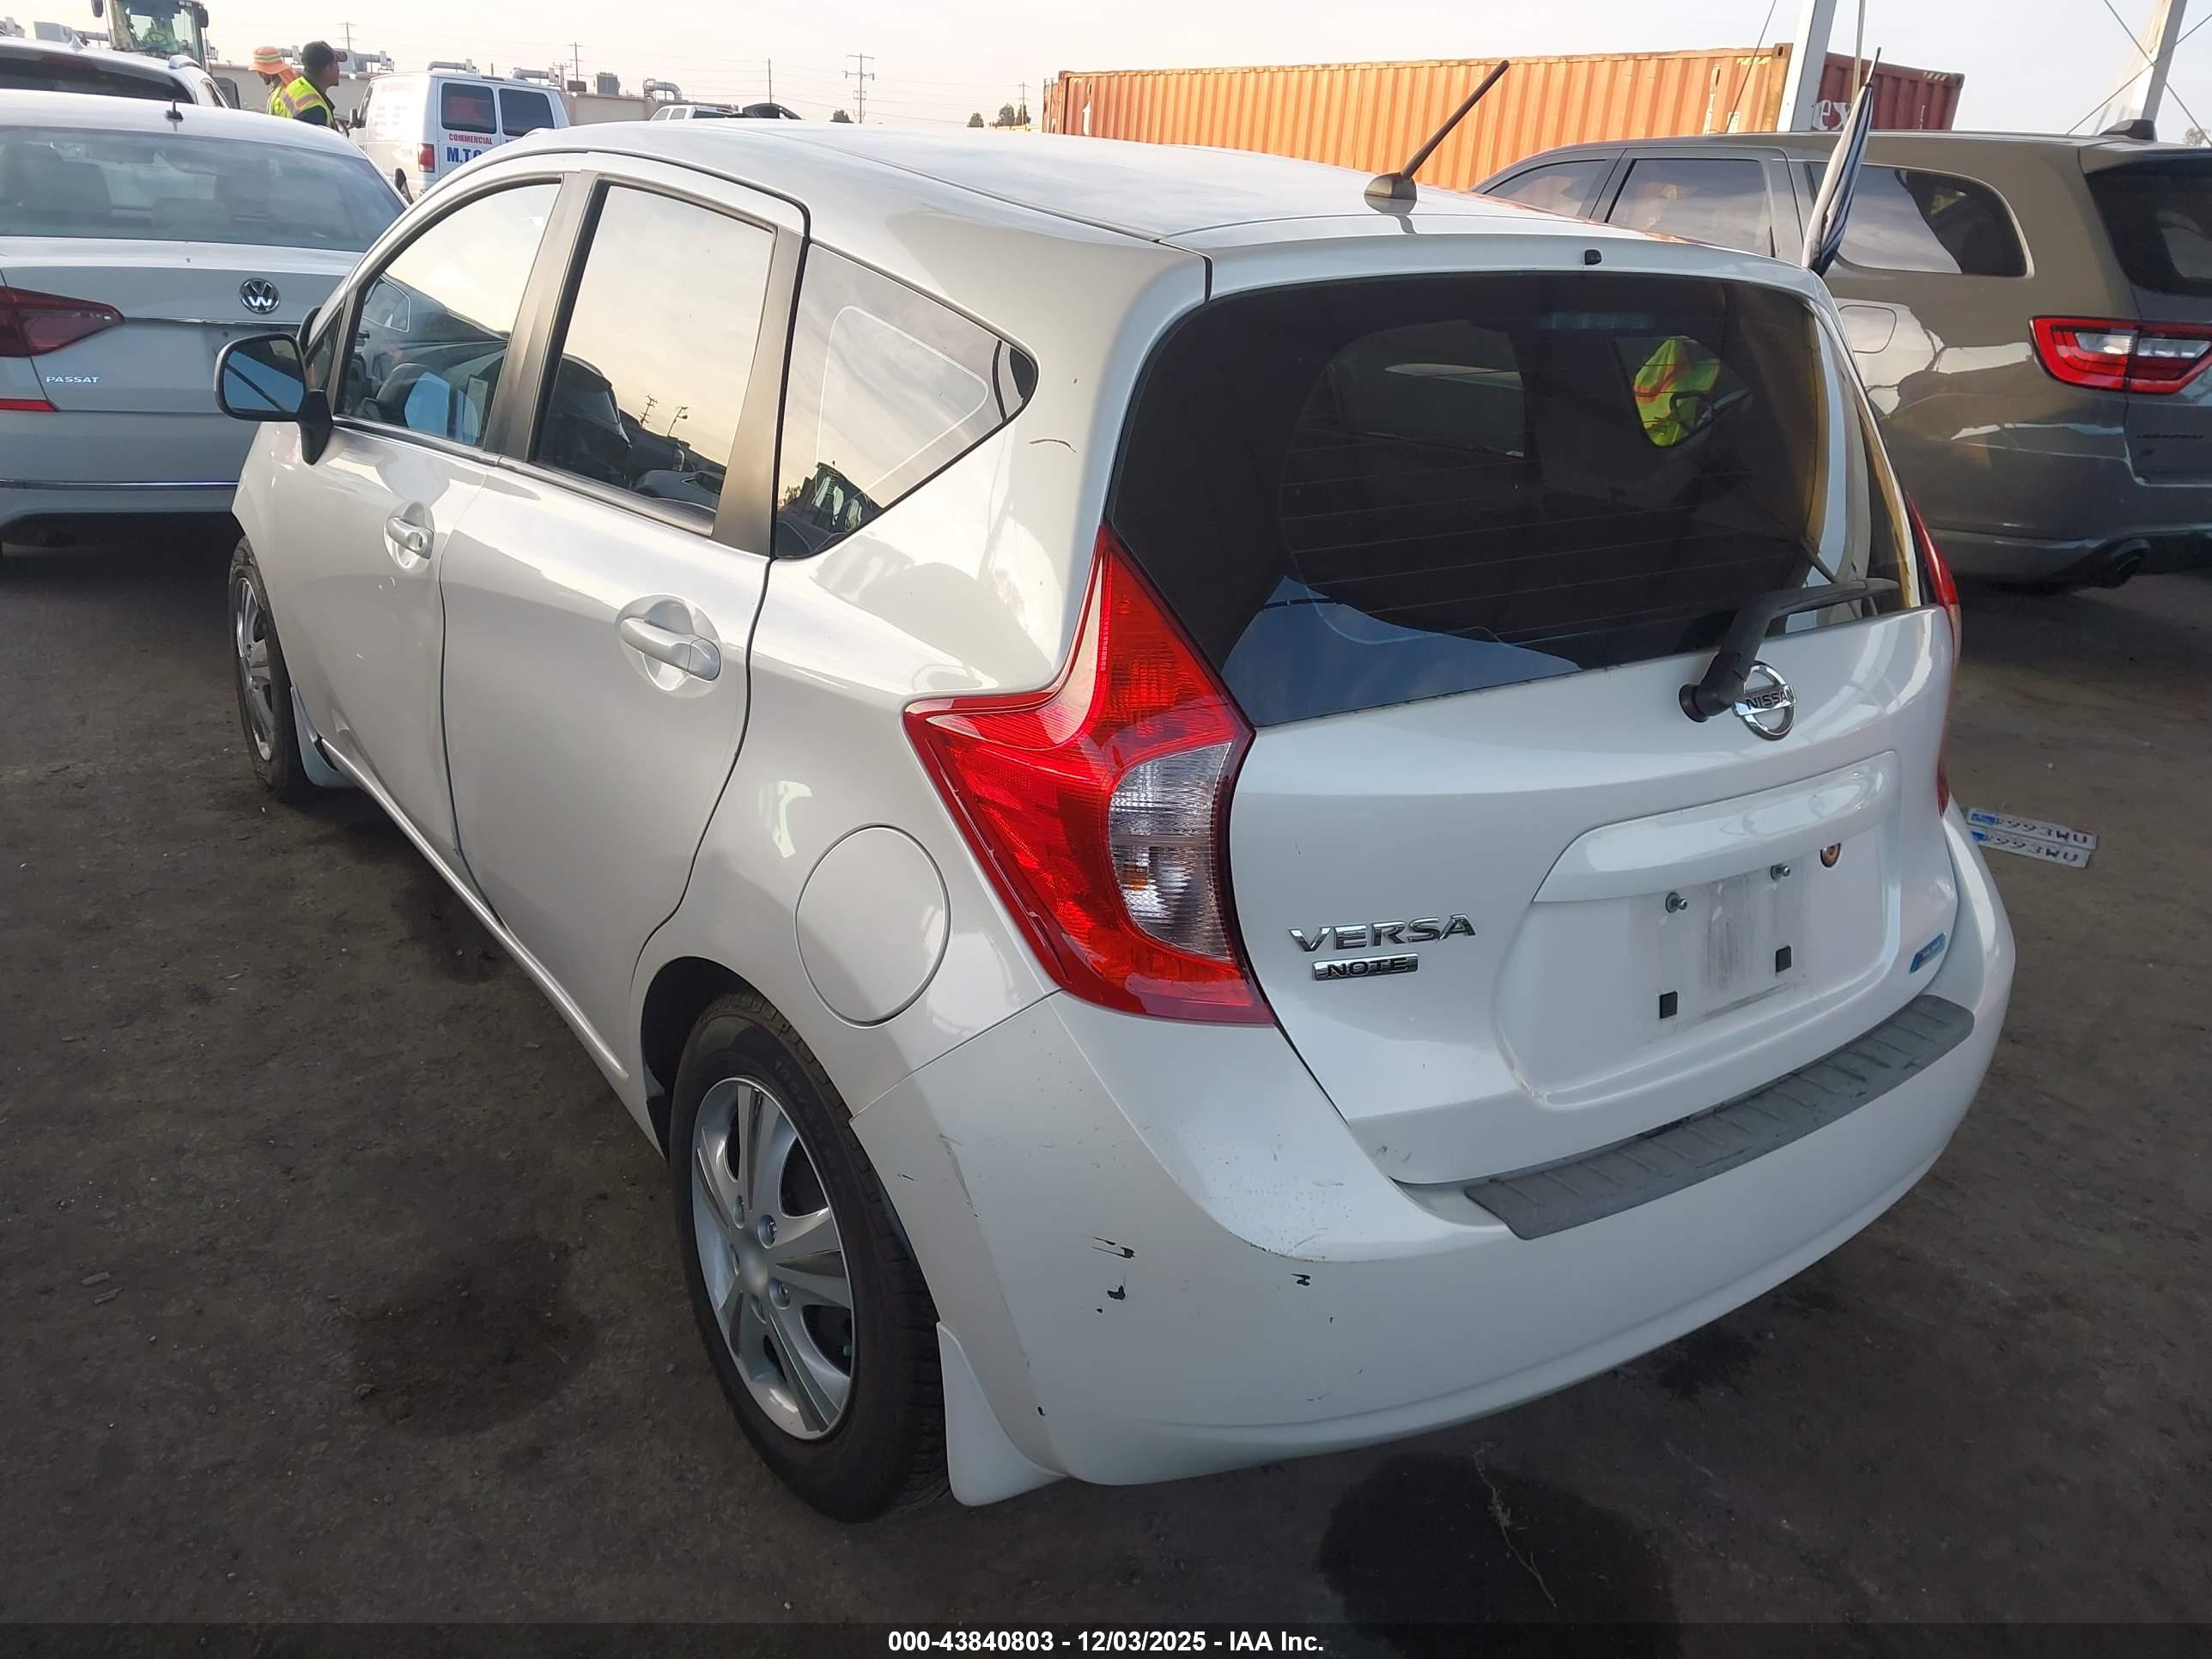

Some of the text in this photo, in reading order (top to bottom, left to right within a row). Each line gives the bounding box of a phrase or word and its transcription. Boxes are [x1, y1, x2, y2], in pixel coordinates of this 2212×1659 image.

[448, 133, 493, 145] COMMERCIAL
[1744, 689, 1796, 710] NISSAN
[1287, 913, 1477, 952] VERSA
[1327, 957, 1409, 979] NOTE
